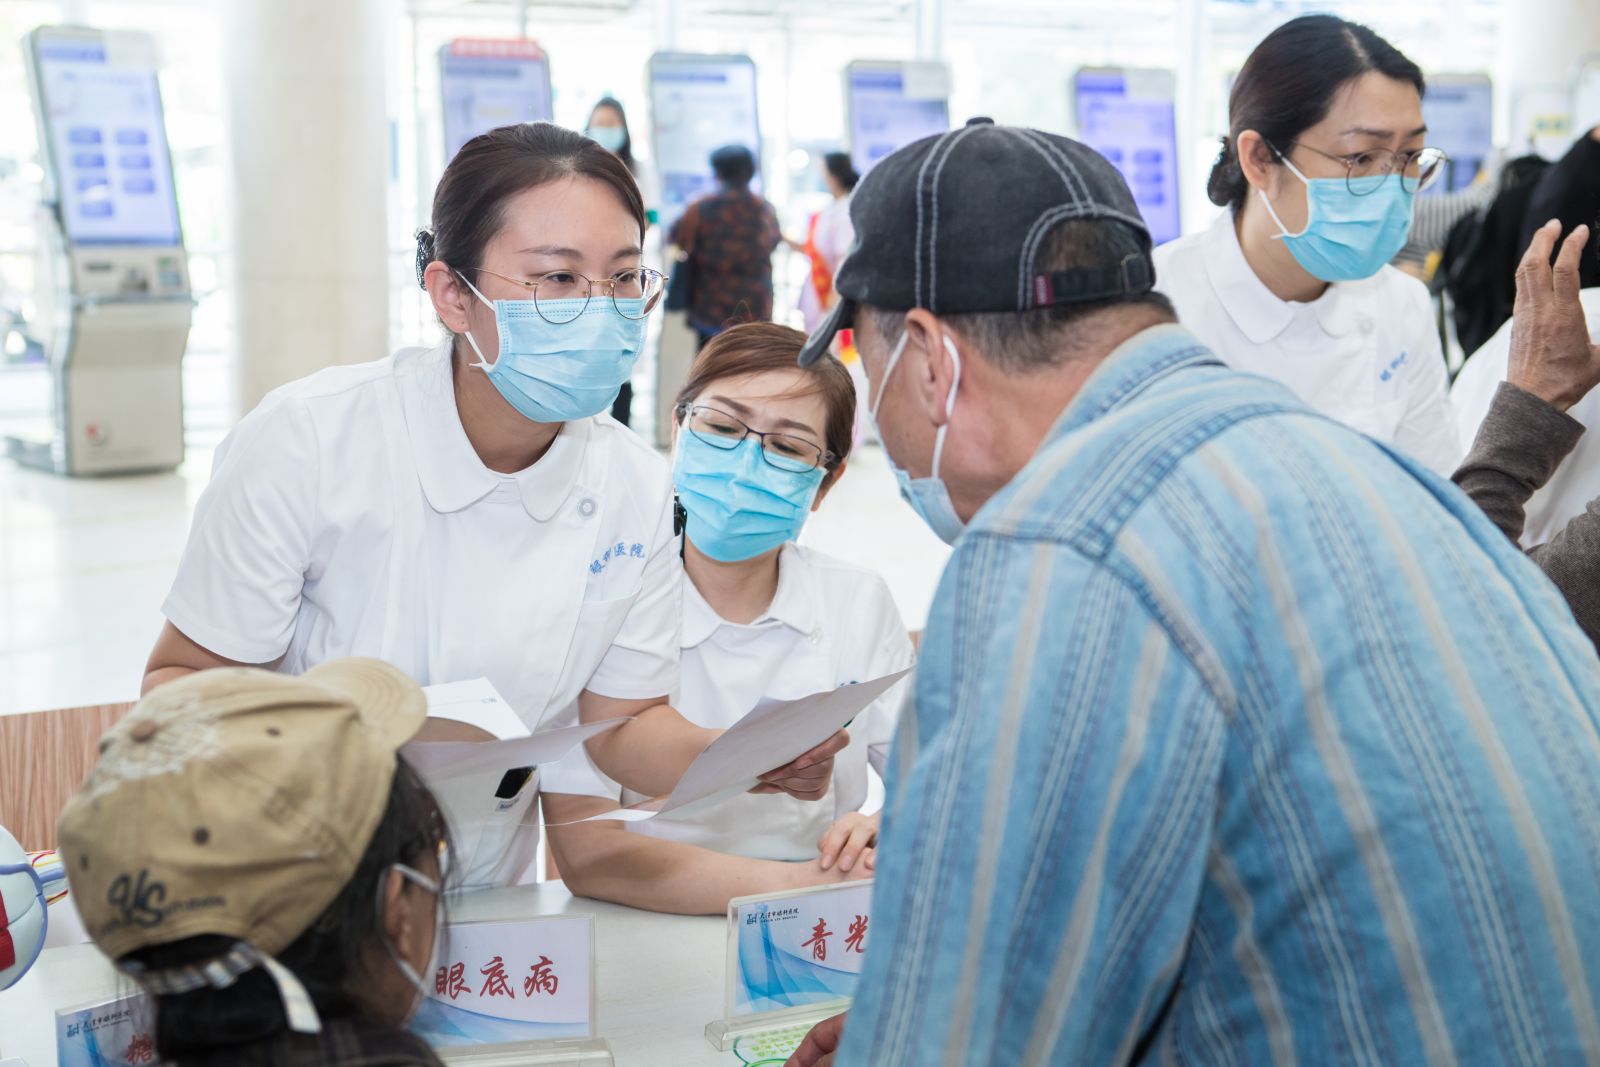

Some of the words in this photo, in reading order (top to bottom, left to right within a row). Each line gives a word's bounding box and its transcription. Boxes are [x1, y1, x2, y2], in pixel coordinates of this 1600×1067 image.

[801, 914, 869, 961] 青光
[435, 955, 559, 1000] 眼底病
